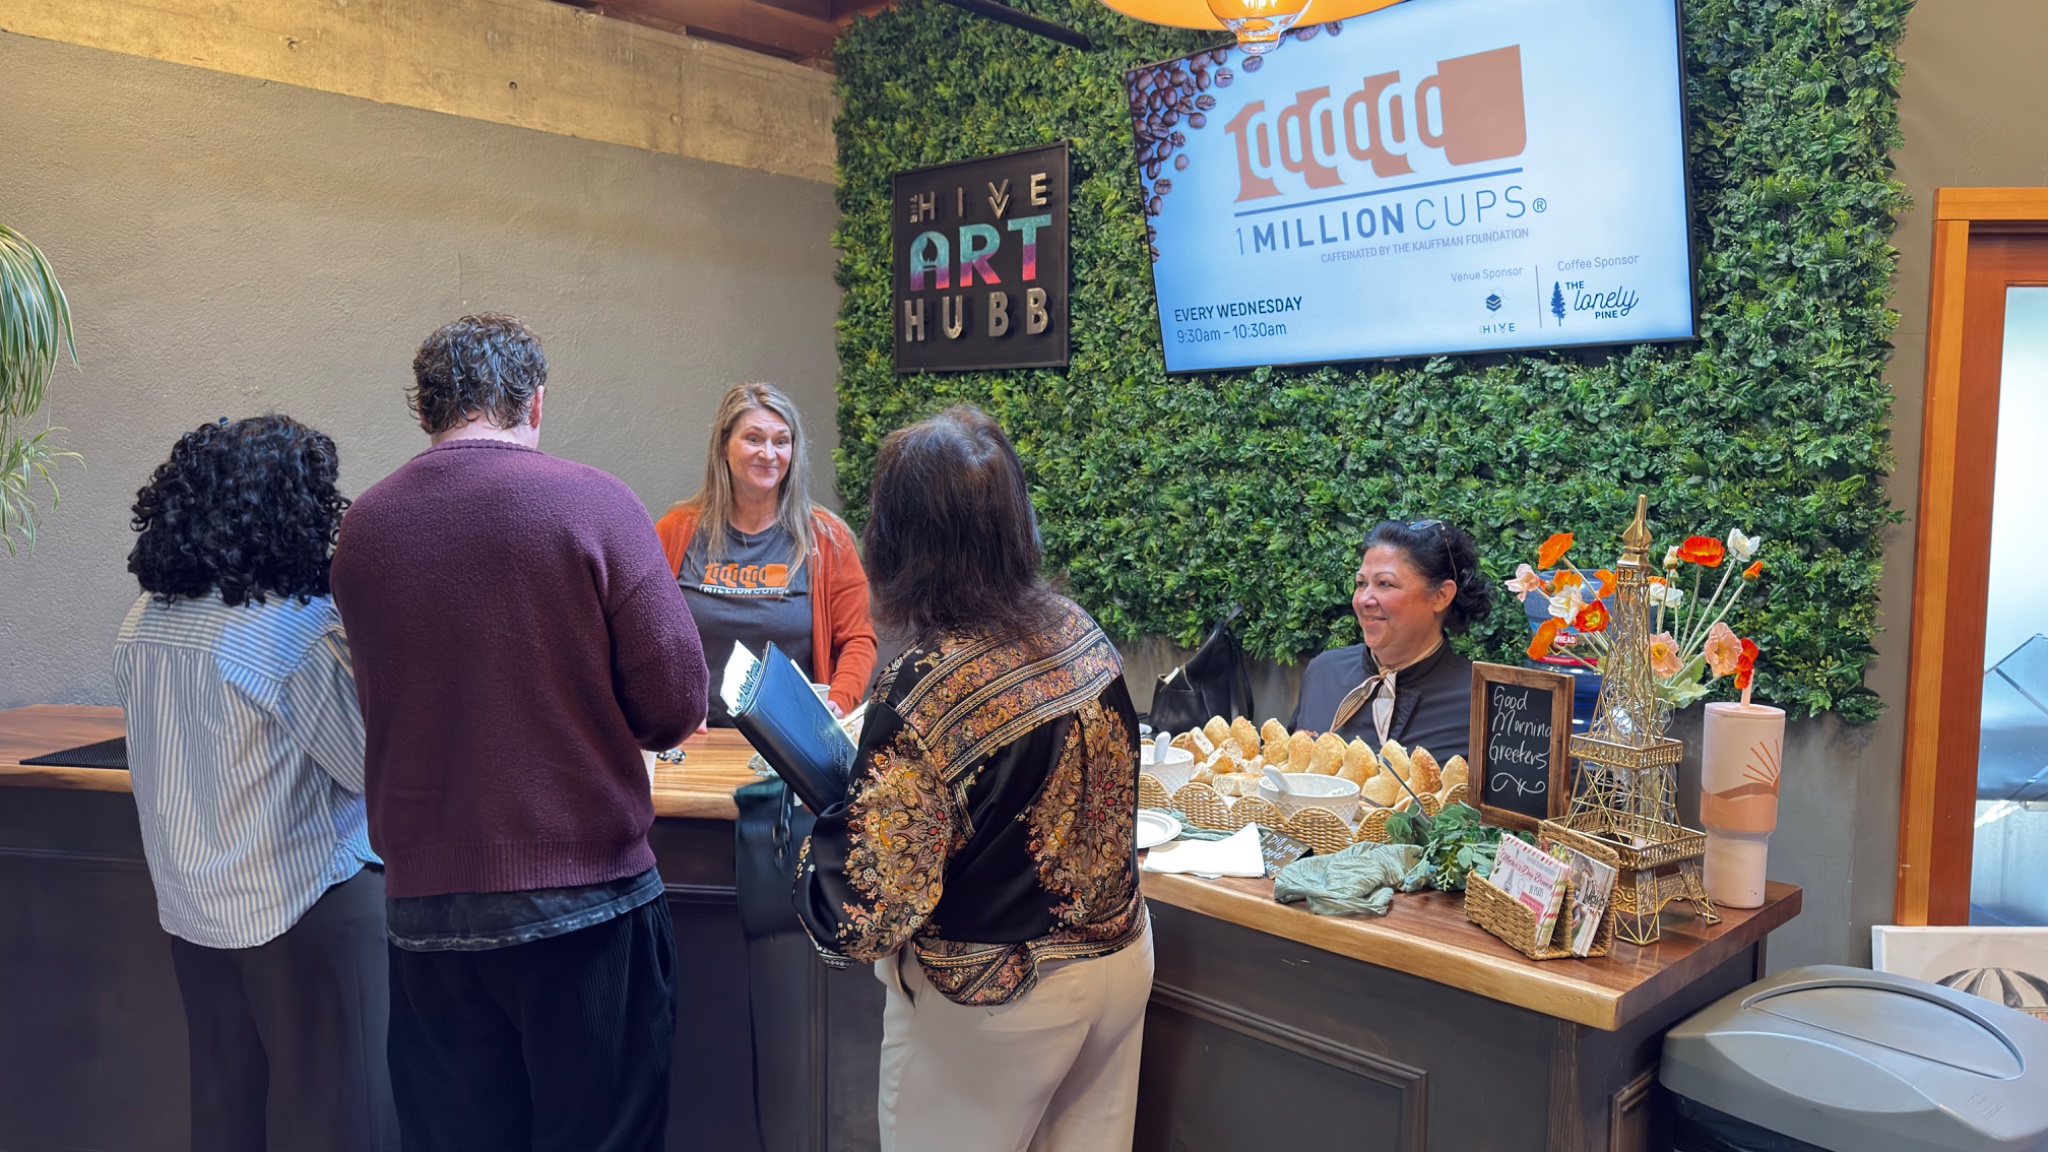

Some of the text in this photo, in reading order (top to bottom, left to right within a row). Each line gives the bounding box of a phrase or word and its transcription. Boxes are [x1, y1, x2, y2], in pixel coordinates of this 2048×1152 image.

[918, 172, 1047, 222] HIVE
[1235, 227, 1244, 255] 1
[1252, 202, 1405, 253] MILLION
[910, 213, 1052, 292] ART
[1320, 227, 1529, 264] CAFFEINATED BY THE KAUFFMAN FOUNDATION
[1450, 266, 1524, 283] Venue Sponsor
[1557, 254, 1639, 272] Coffee Sponsor
[1565, 280, 1585, 290] THE
[904, 286, 1049, 343] HUBB
[1174, 295, 1302, 322] EVERY WEDNESDAY
[1573, 285, 1640, 317] lonely
[1595, 310, 1618, 320] PINE
[1176, 328, 1221, 344] 9:30am
[1232, 322, 1287, 339] 10:30am
[1482, 322, 1516, 334] HIVE
[1493, 685, 1529, 713] Good
[1489, 733, 1547, 769] Greeters
